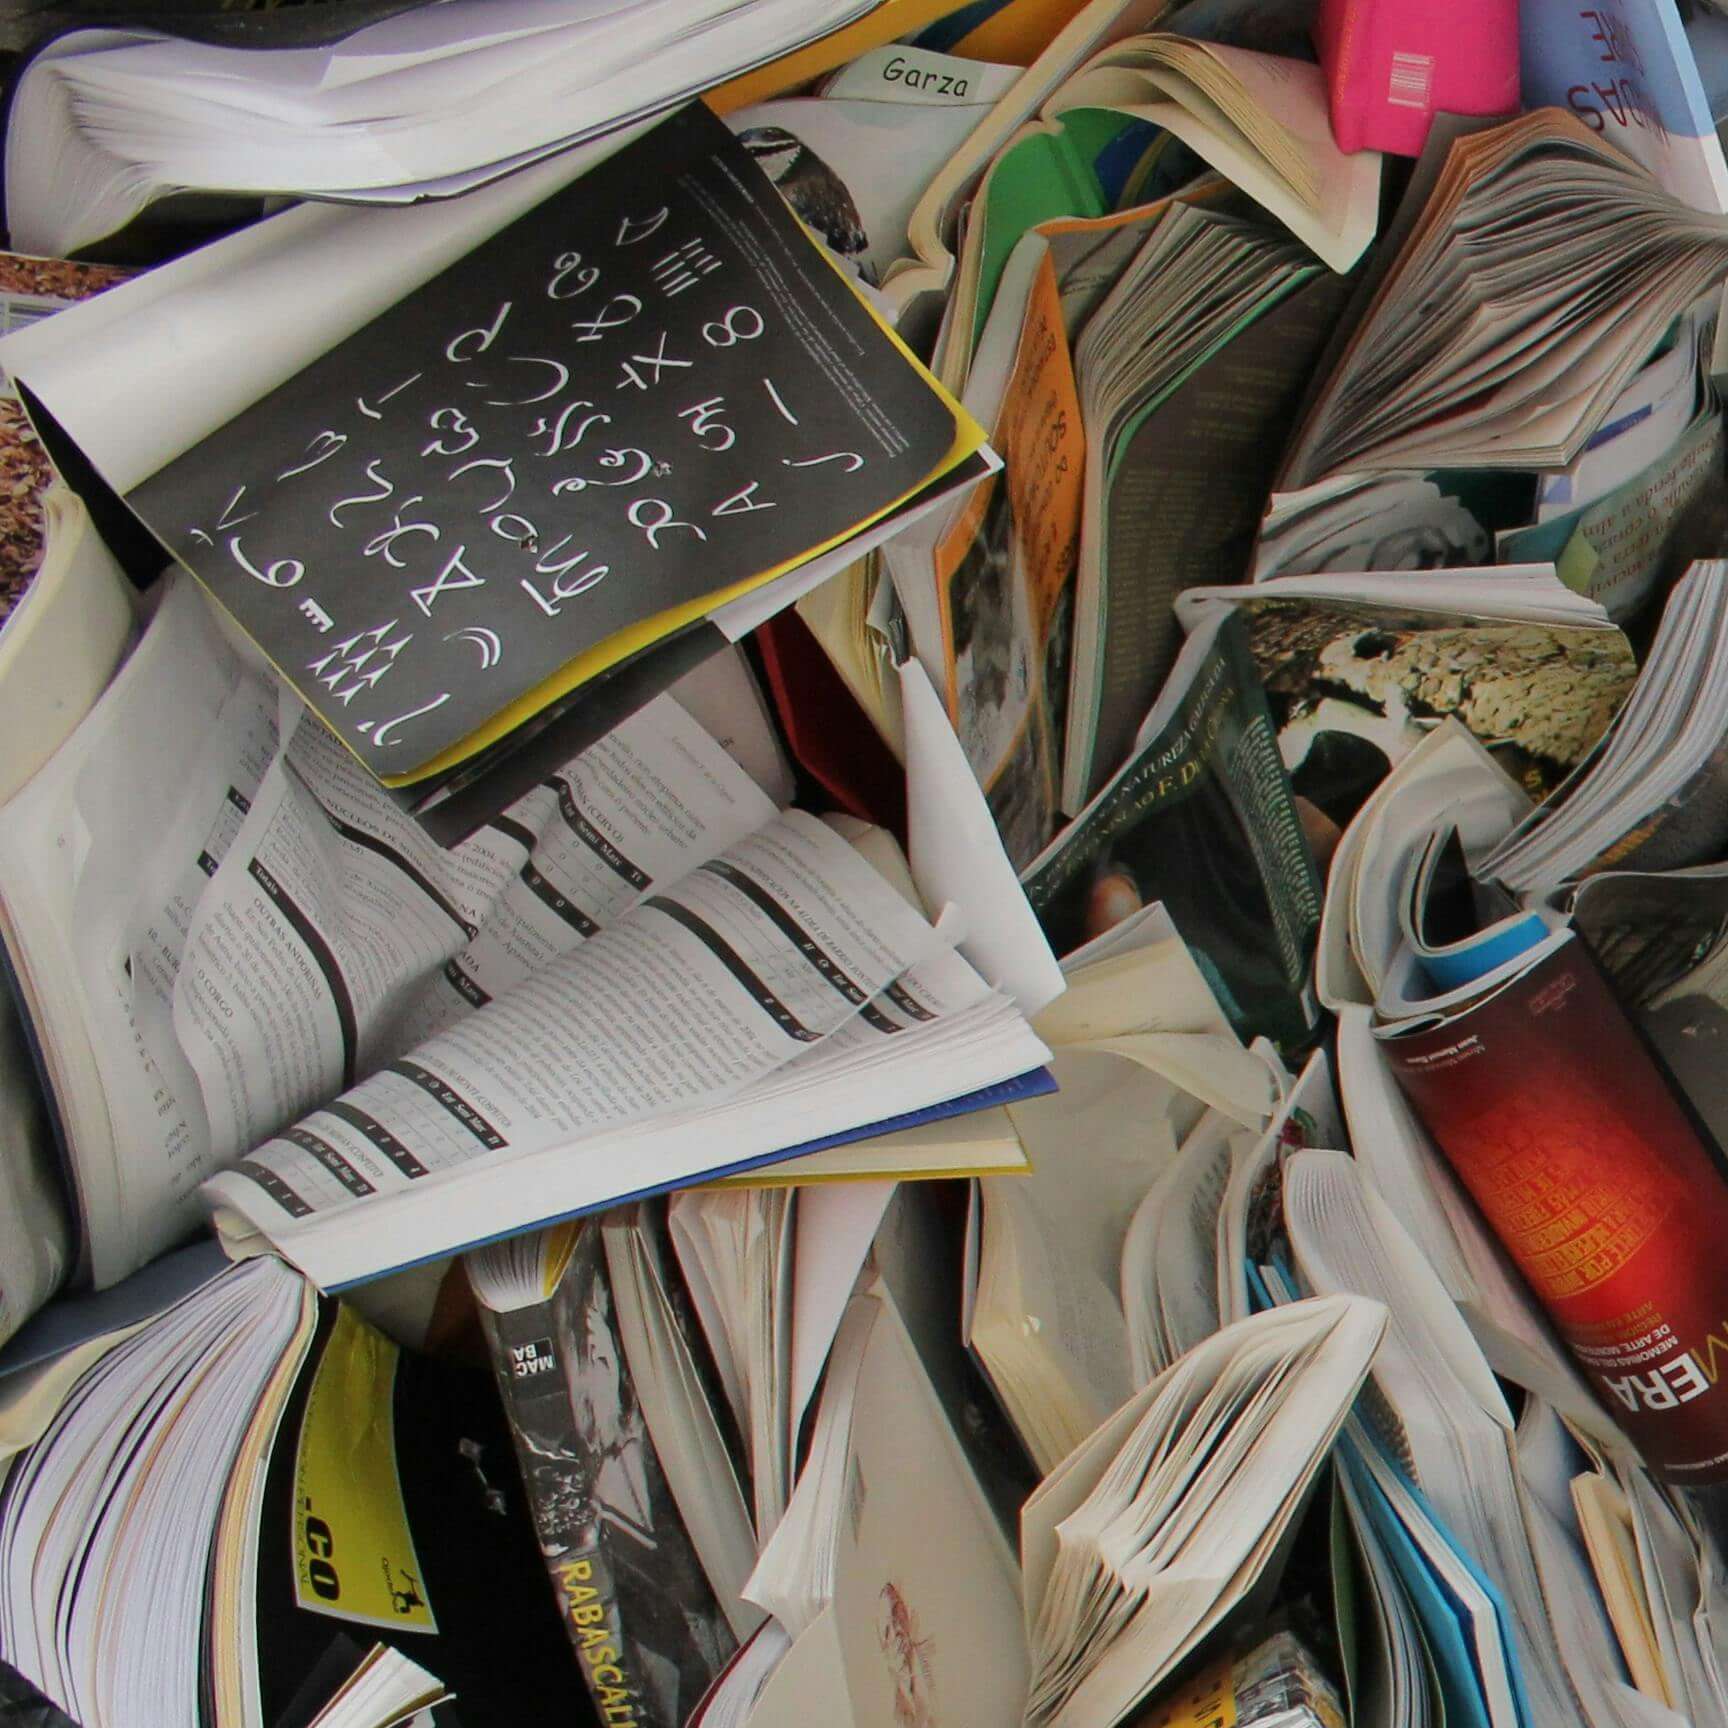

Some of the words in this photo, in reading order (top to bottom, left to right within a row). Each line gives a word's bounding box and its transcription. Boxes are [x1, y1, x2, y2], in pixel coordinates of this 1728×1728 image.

[882, 57, 969, 97] Garza
[511, 1342, 537, 1361] BA
[514, 1354, 555, 1378] MAC
